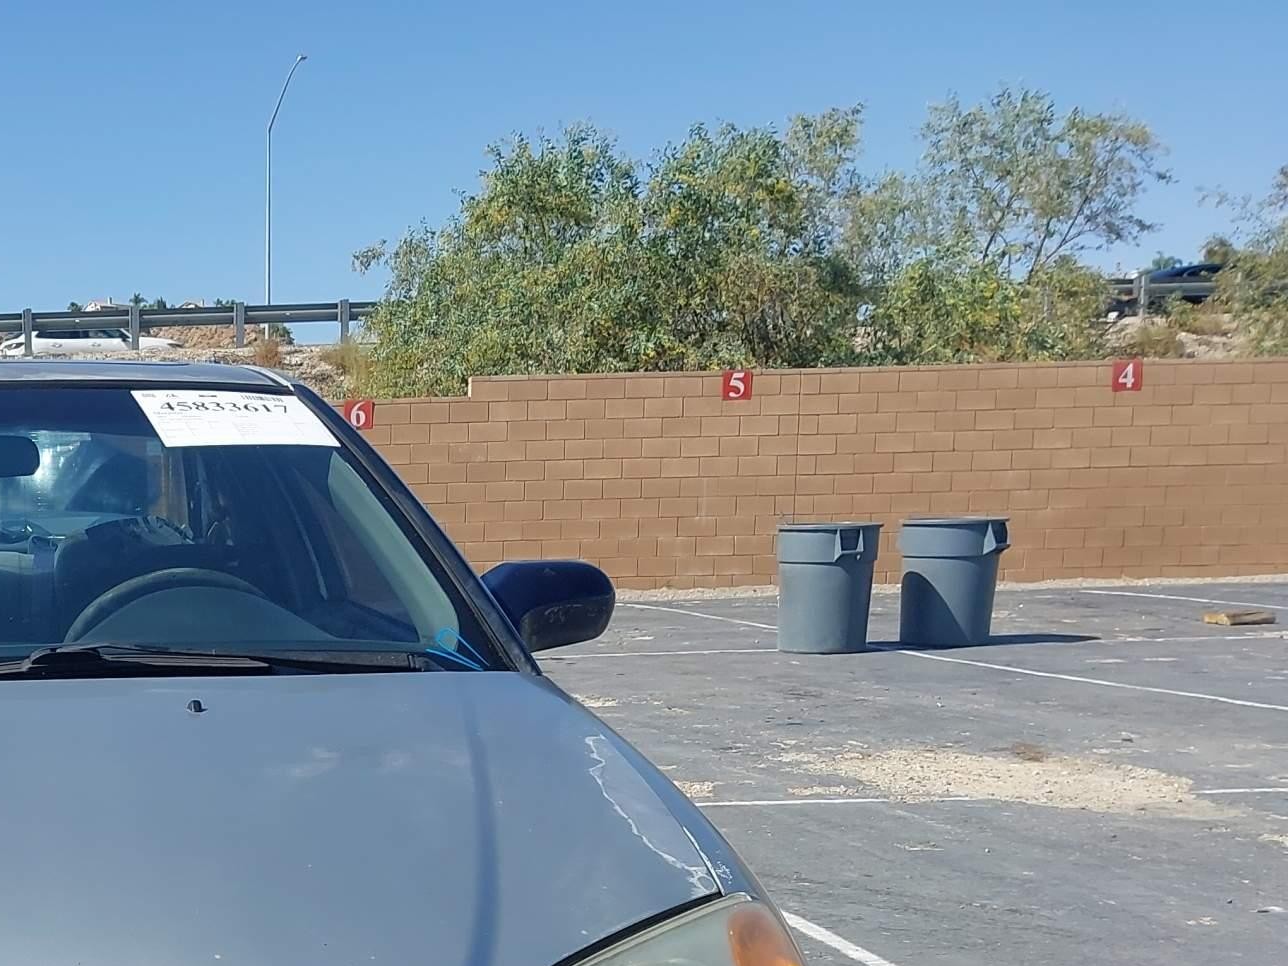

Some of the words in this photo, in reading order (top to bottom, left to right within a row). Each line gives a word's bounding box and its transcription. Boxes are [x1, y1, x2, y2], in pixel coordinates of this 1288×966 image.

[729, 373, 745, 397] 5
[1119, 364, 1134, 388] 4
[160, 401, 288, 414] 45833617
[351, 402, 366, 427] 6
